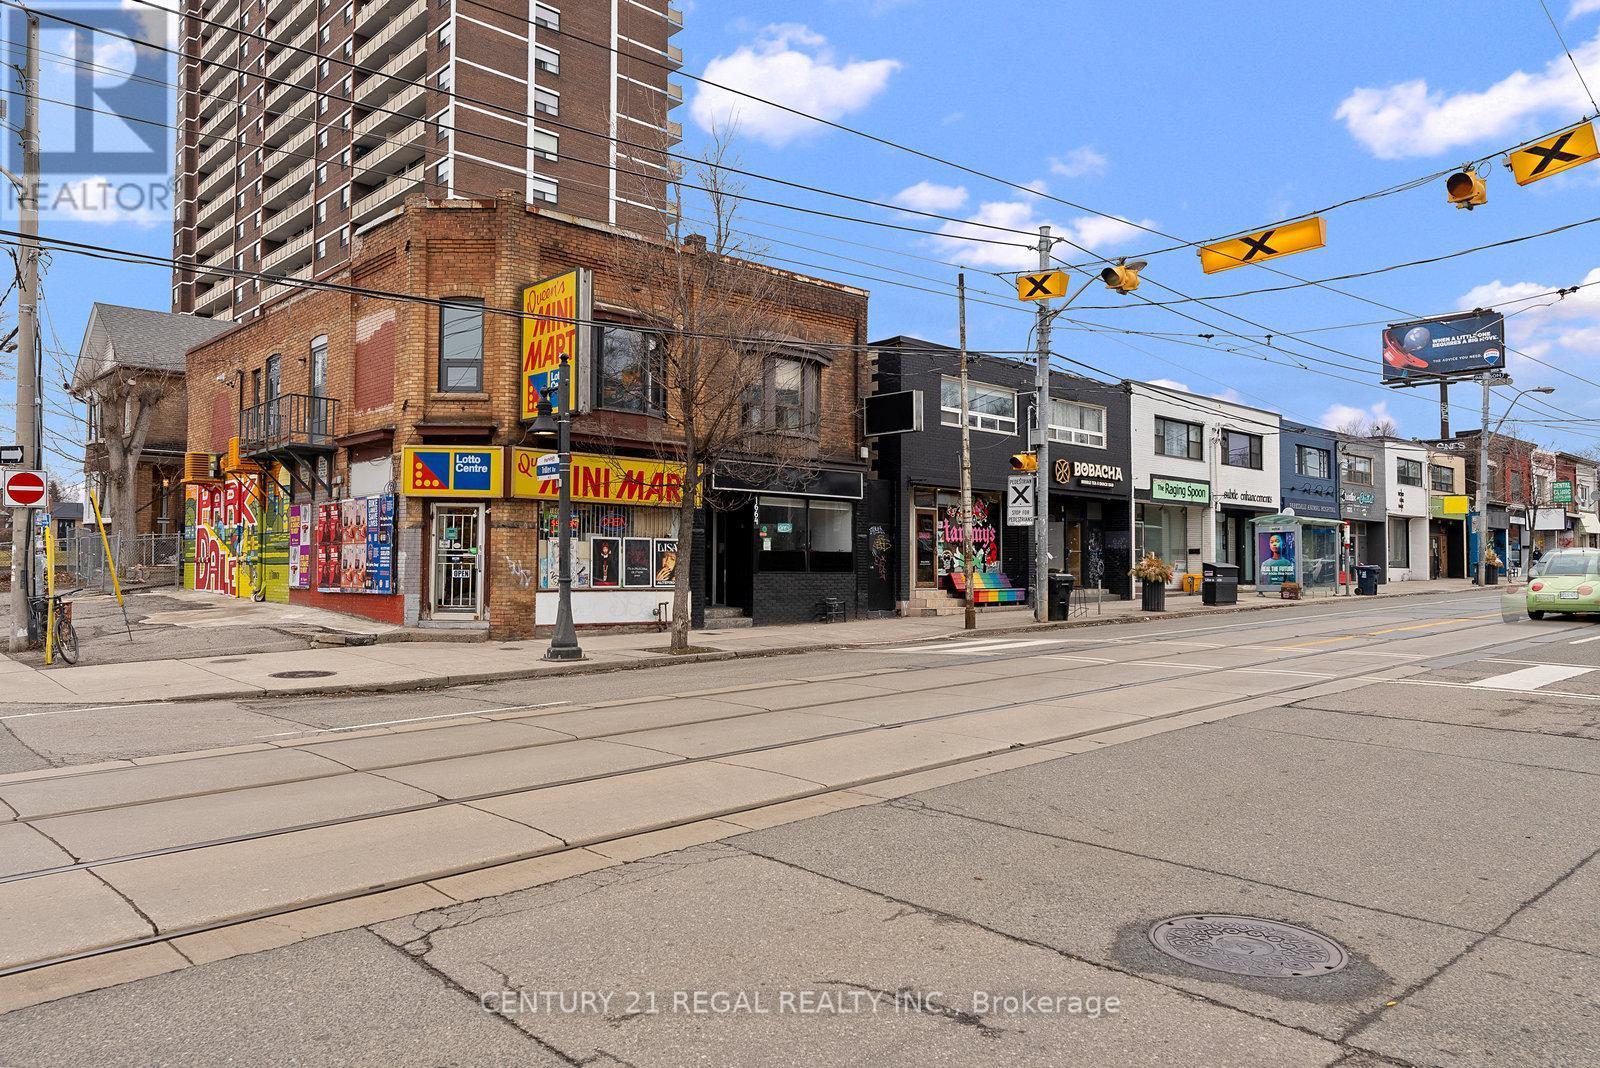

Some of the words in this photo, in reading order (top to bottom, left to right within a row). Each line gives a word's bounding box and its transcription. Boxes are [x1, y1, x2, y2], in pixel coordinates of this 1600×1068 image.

[527, 280, 566, 314] Queen's
[533, 295, 574, 338] MINI
[1432, 336, 1451, 344] WHEN
[1432, 340, 1461, 348] REQUIRES
[524, 329, 576, 372] MART
[456, 454, 482, 464] Lotto
[455, 464, 489, 474] Centre
[1073, 461, 1124, 481] BOBACHA
[1164, 483, 1186, 499] Raging
[1187, 485, 1206, 499] Spoon
[1223, 489, 1239, 500] subtle
[1239, 490, 1273, 504] enhancements
[195, 473, 259, 529] PARK
[657, 543, 678, 553] LISA
[194, 525, 238, 600] DALE
